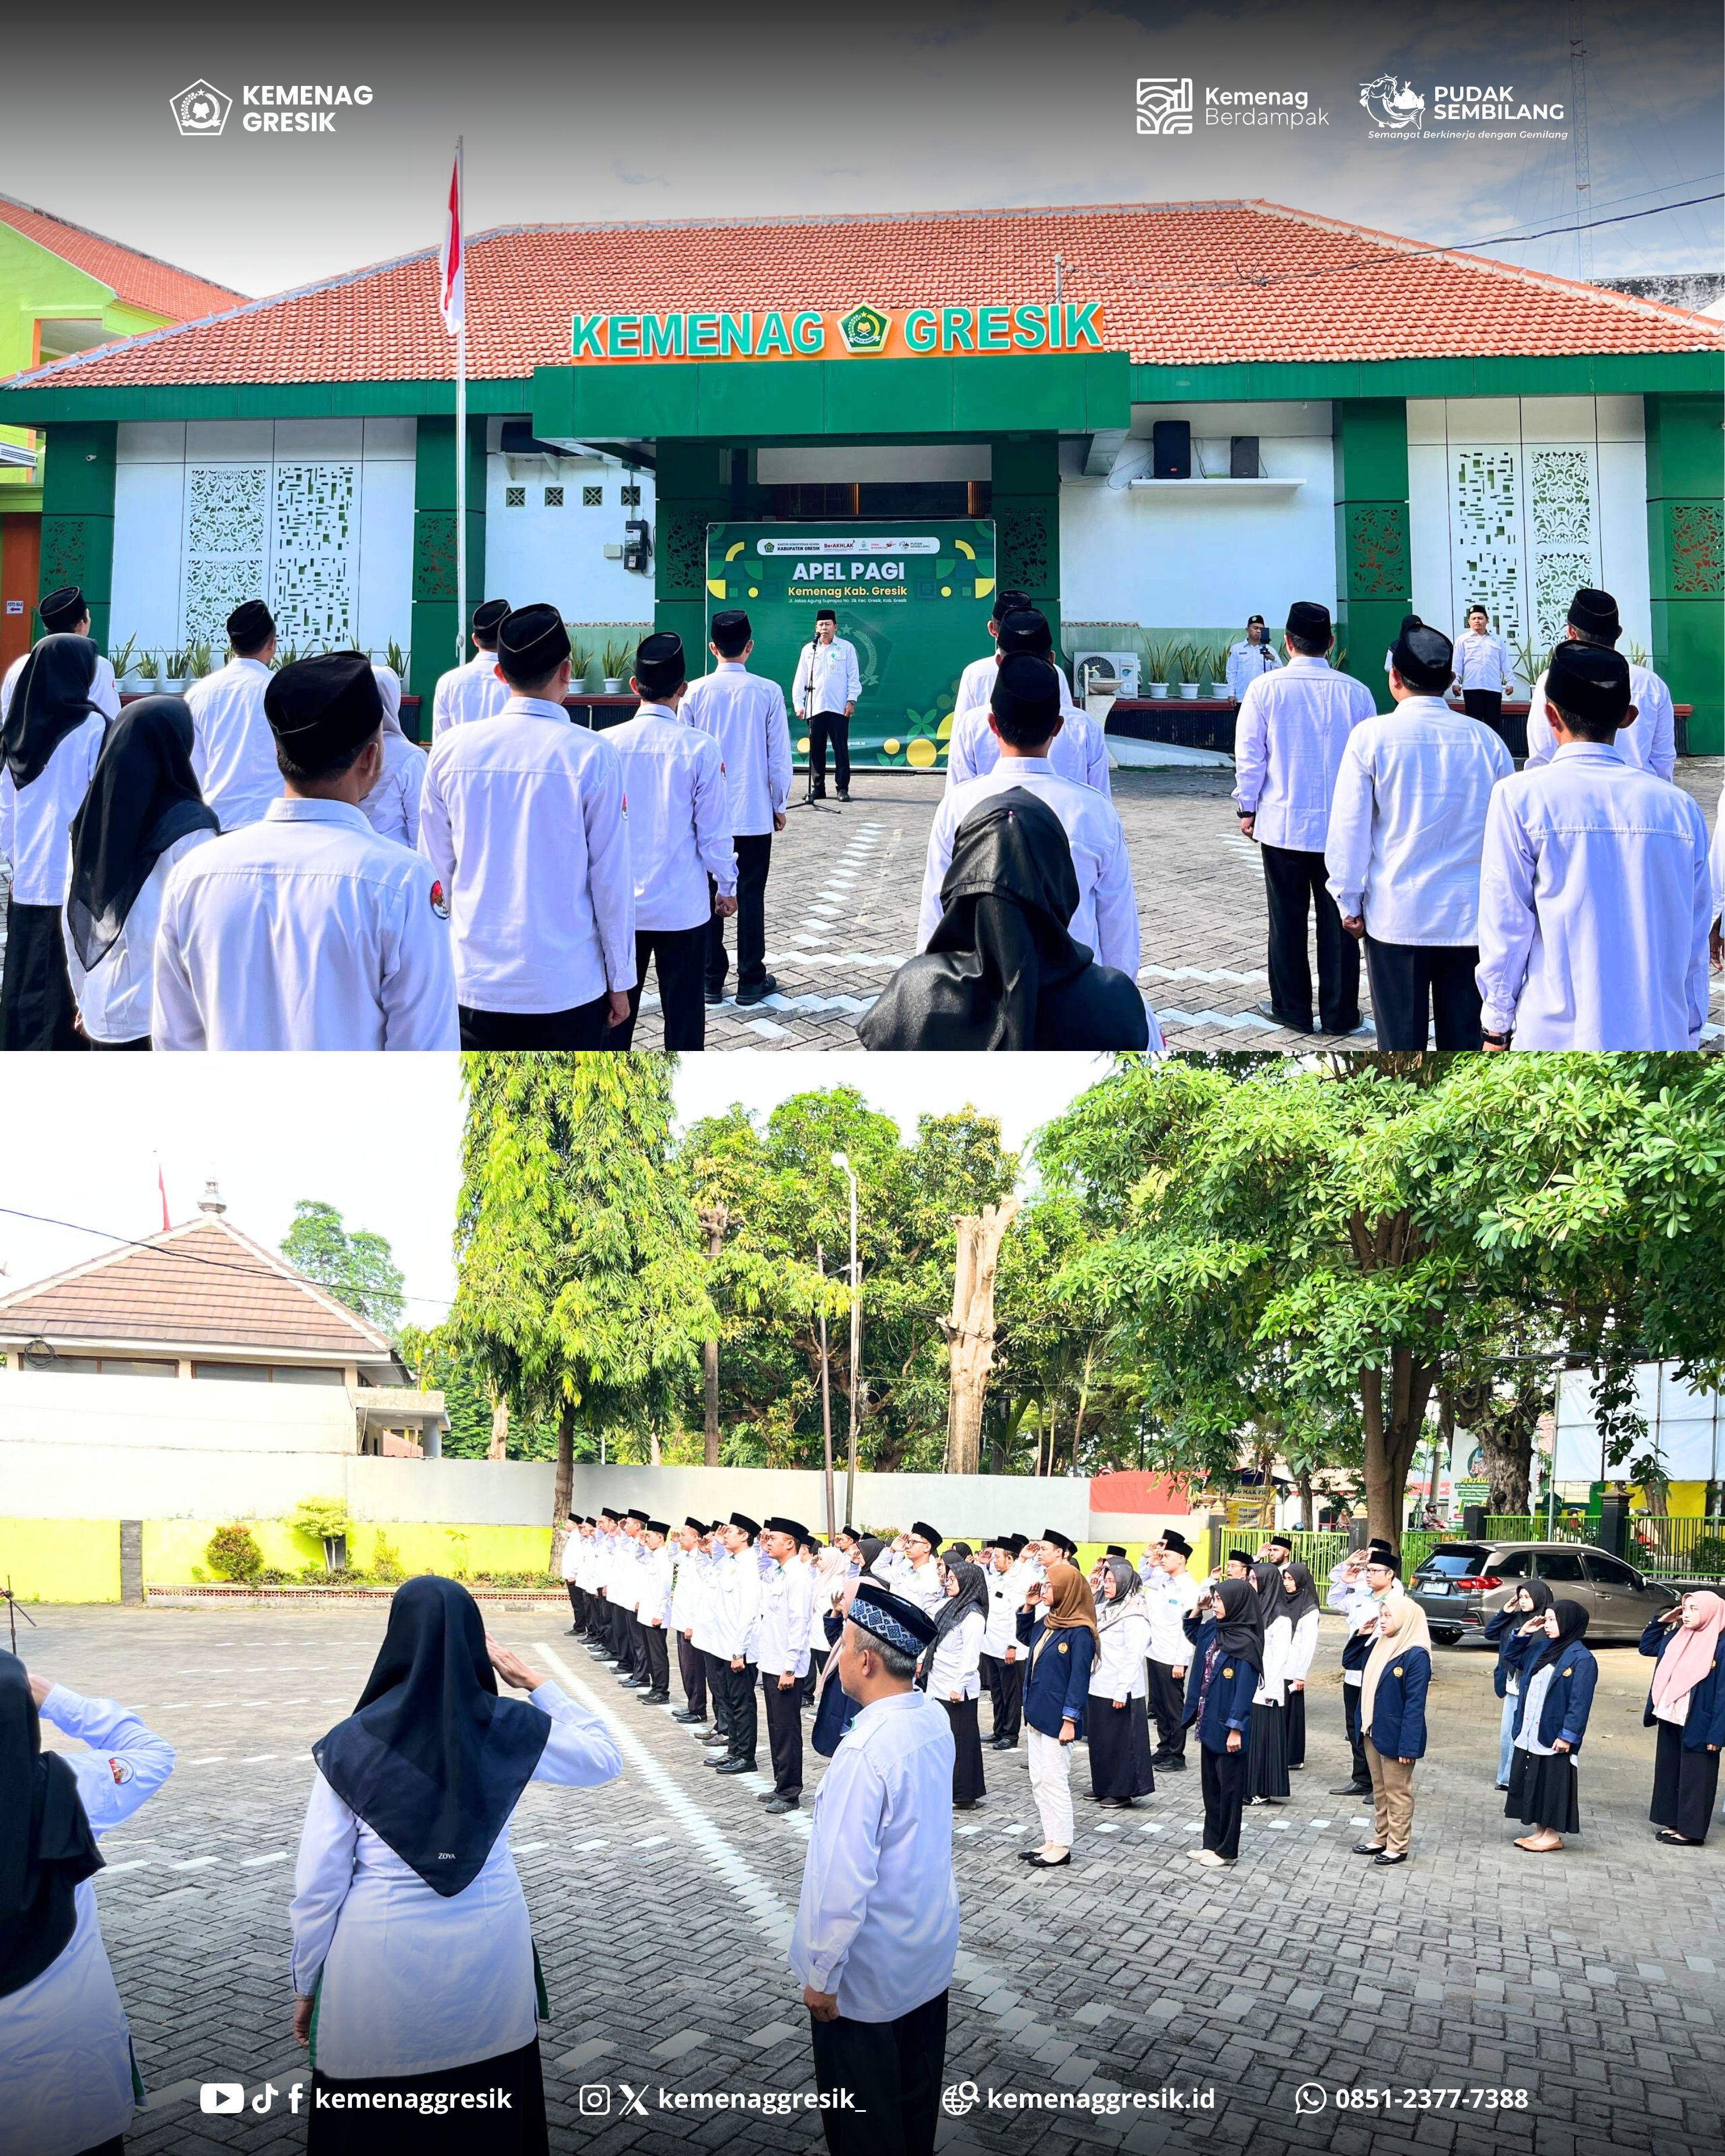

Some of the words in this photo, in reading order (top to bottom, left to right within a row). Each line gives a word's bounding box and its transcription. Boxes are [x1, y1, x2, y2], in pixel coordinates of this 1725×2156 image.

[572, 311, 825, 357] KEMENAG
[904, 303, 1102, 352] GRESIK
[792, 562, 846, 580] APEL
[850, 562, 905, 580] PAGI
[788, 586, 842, 599] Kemenag
[844, 586, 869, 595] Kab.
[871, 585, 908, 595] Gresik
